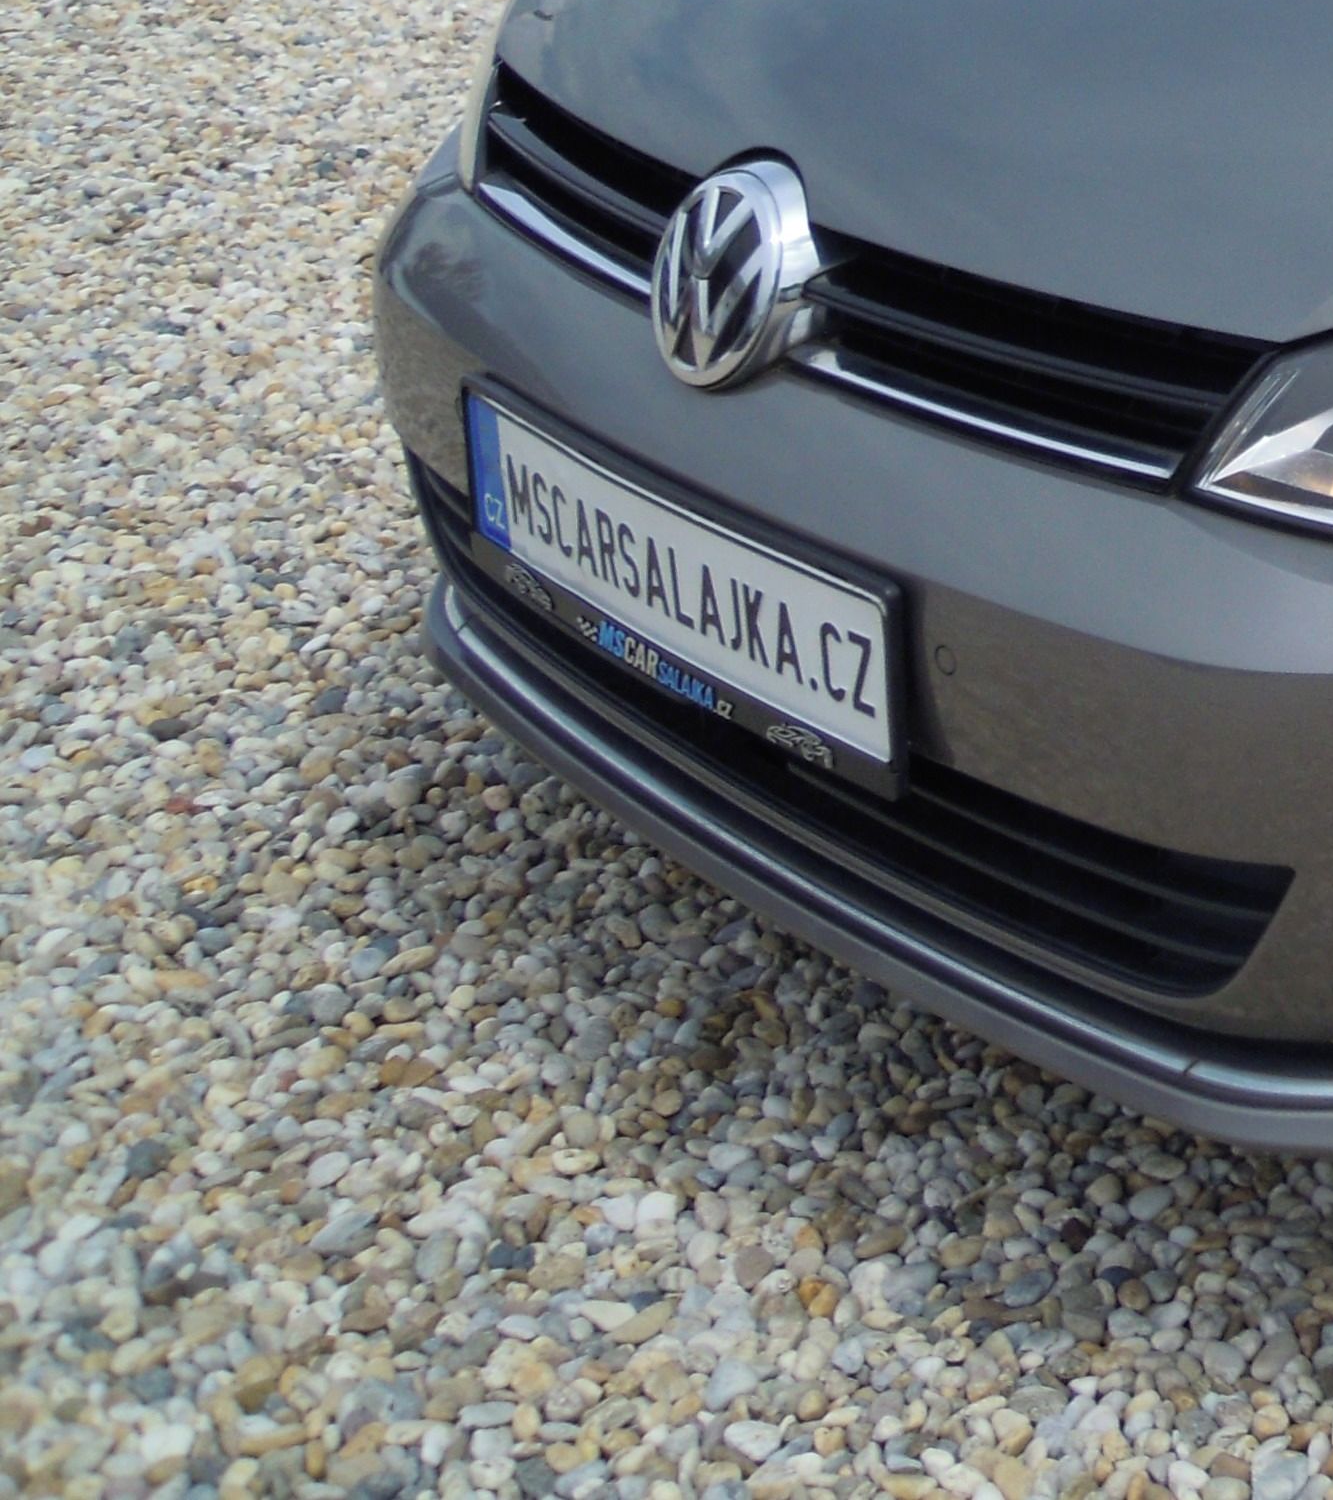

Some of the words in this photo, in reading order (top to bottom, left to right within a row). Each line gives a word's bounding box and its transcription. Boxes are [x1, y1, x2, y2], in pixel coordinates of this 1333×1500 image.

[651, 170, 783, 387] VW
[484, 492, 506, 531] CZ
[506, 452, 876, 719] MSCARSALAJKA.CZ
